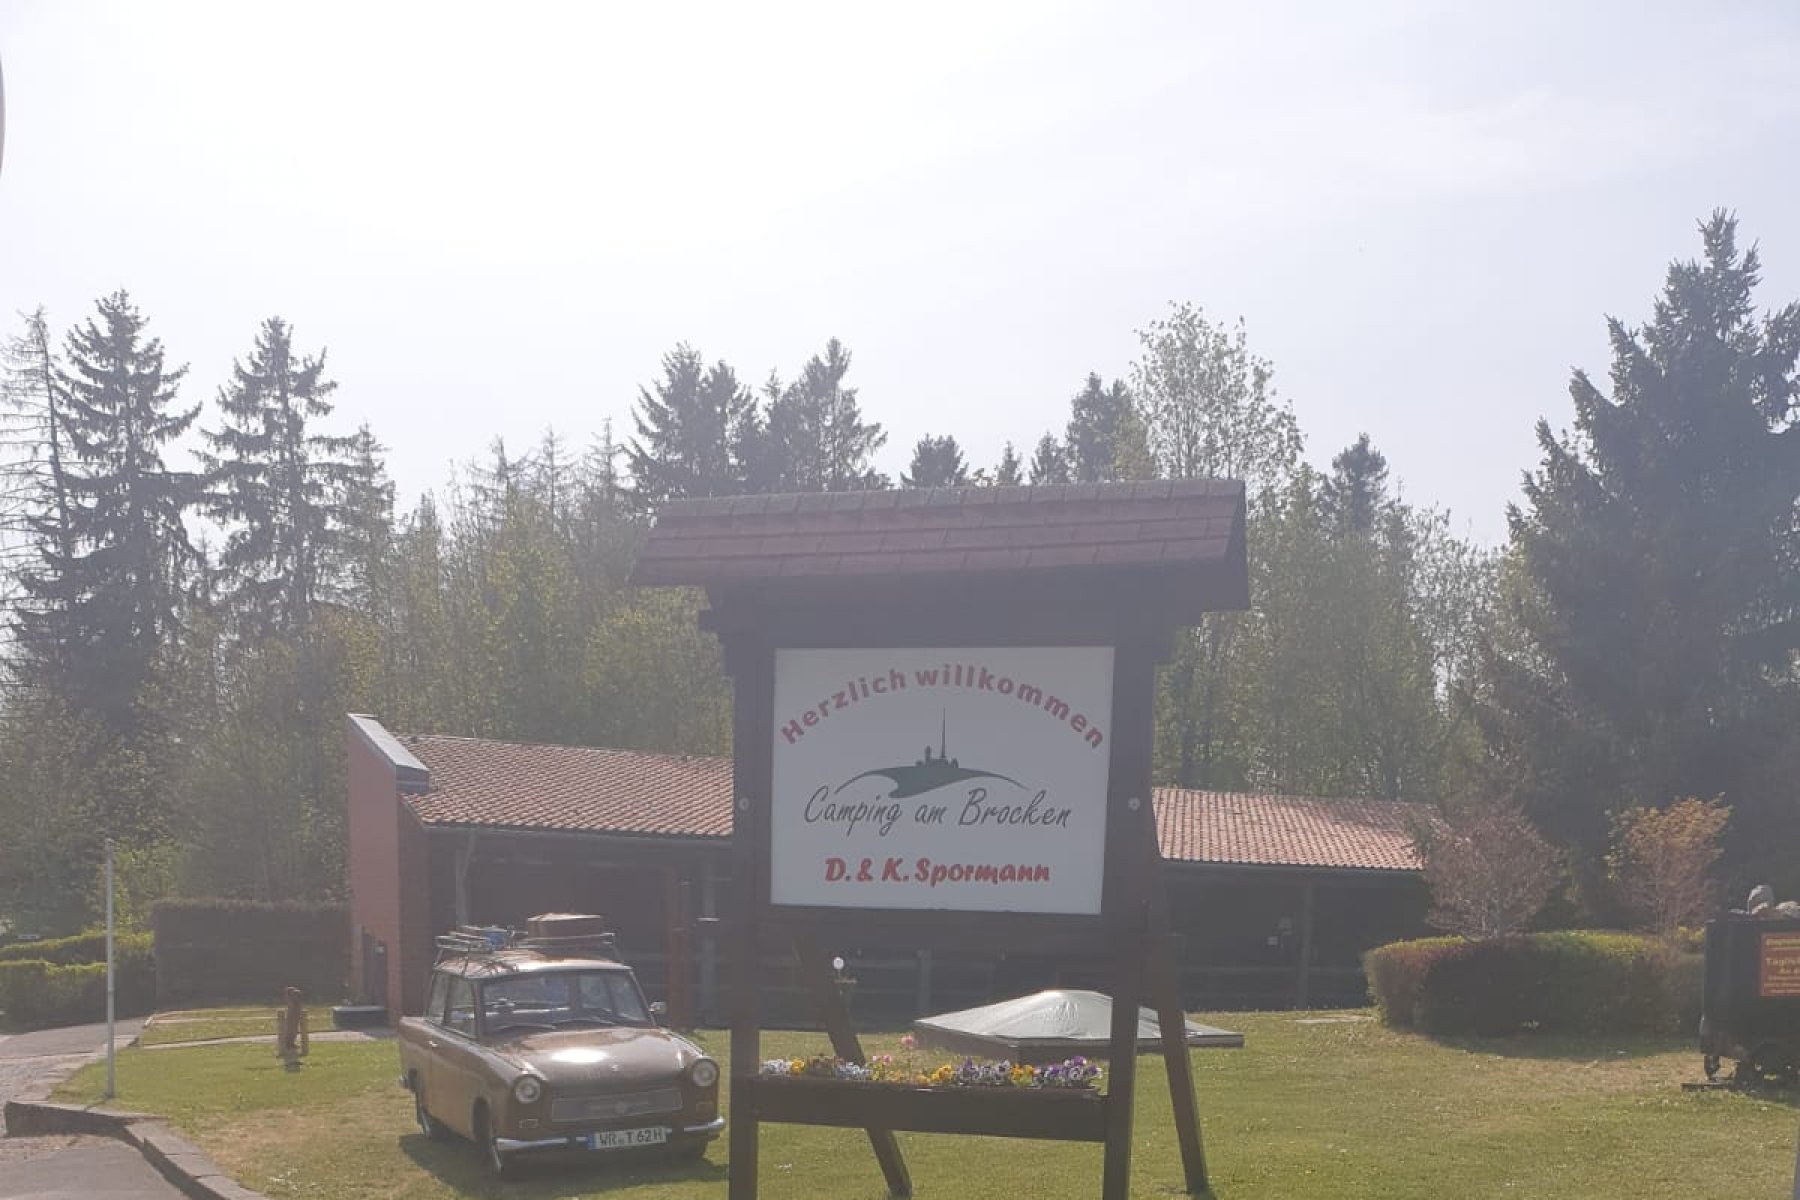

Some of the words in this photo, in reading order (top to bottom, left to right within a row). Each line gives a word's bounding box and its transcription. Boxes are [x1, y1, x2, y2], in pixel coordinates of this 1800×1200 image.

[781, 668, 906, 745] Herzlich
[915, 663, 1103, 748] willkommen
[804, 785, 903, 837] Camping
[914, 800, 948, 824] am
[958, 787, 1071, 828] Brocken
[825, 857, 851, 882] D.
[857, 857, 874, 882] &
[882, 857, 910, 882] K.
[914, 857, 1050, 887] Spormann
